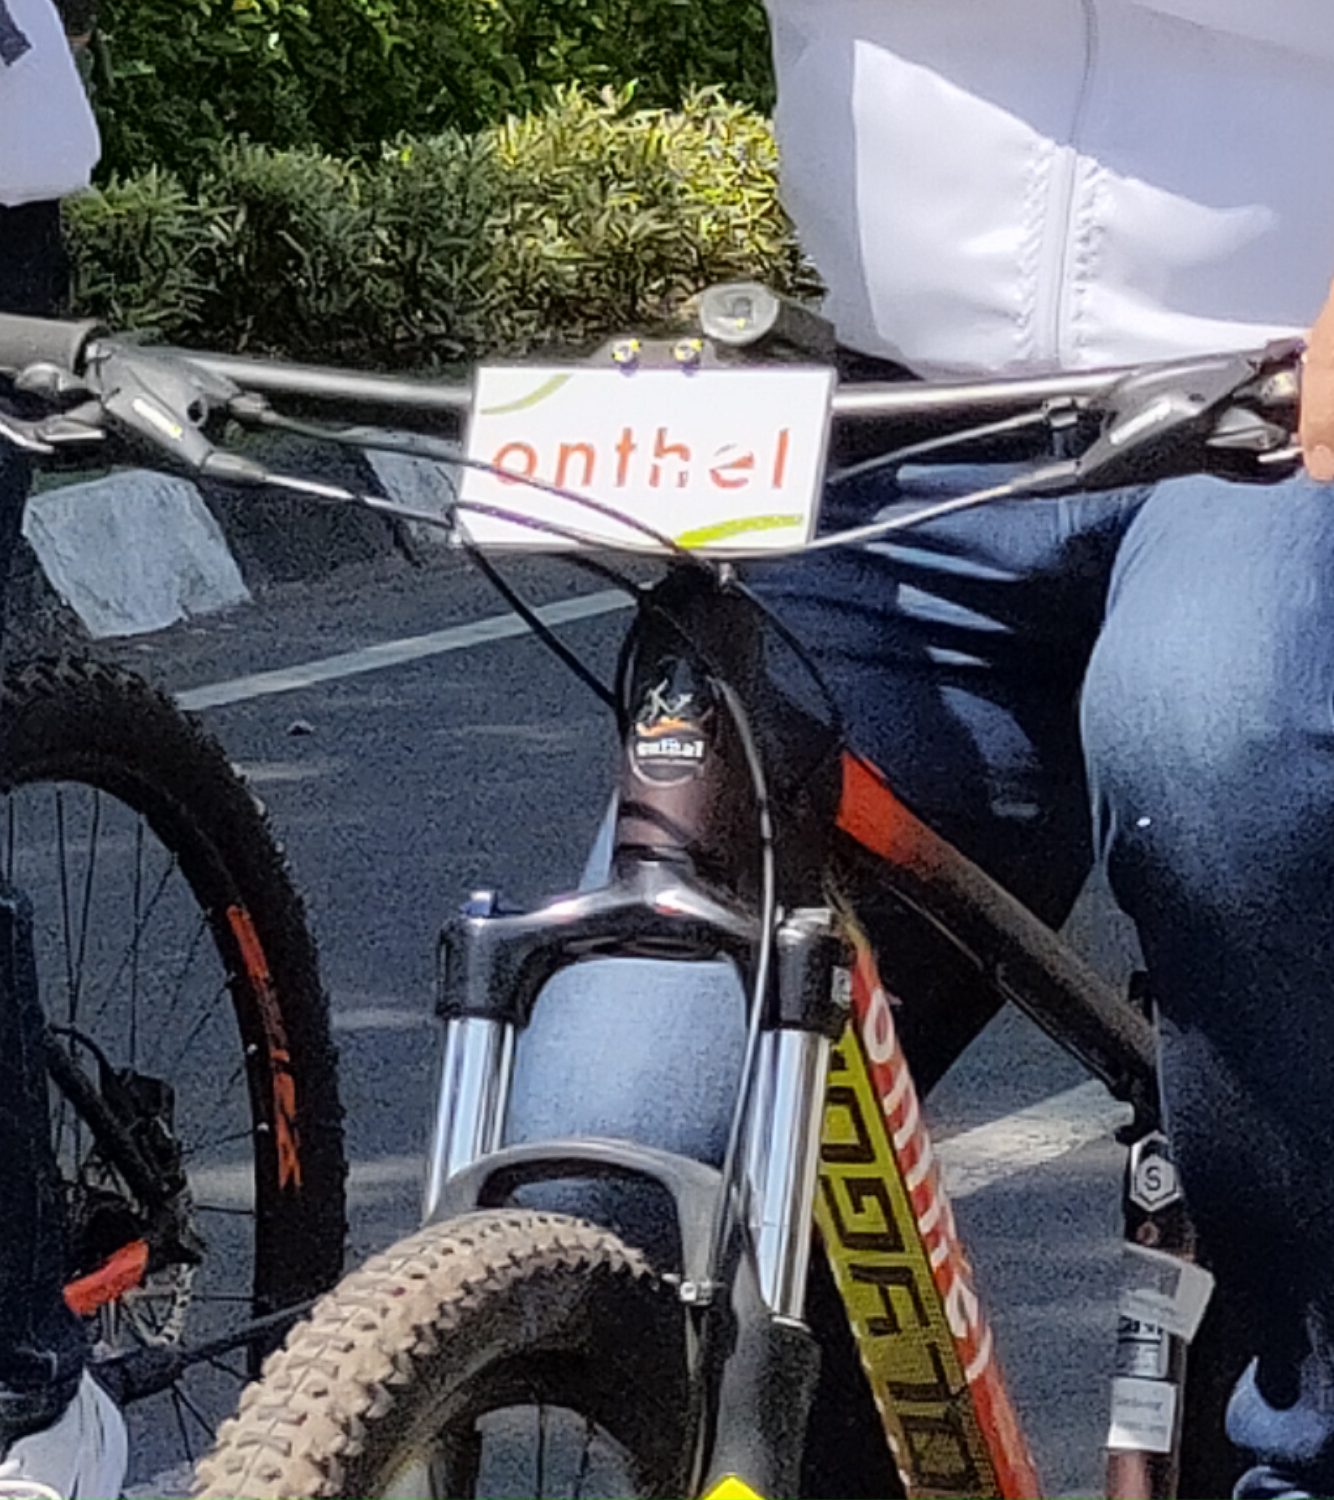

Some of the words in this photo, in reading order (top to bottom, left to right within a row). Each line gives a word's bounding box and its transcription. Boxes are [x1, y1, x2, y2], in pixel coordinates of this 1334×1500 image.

[493, 427, 788, 488] onthel
[1144, 1165, 1162, 1192] S
[823, 1045, 989, 1499] OLYGO
